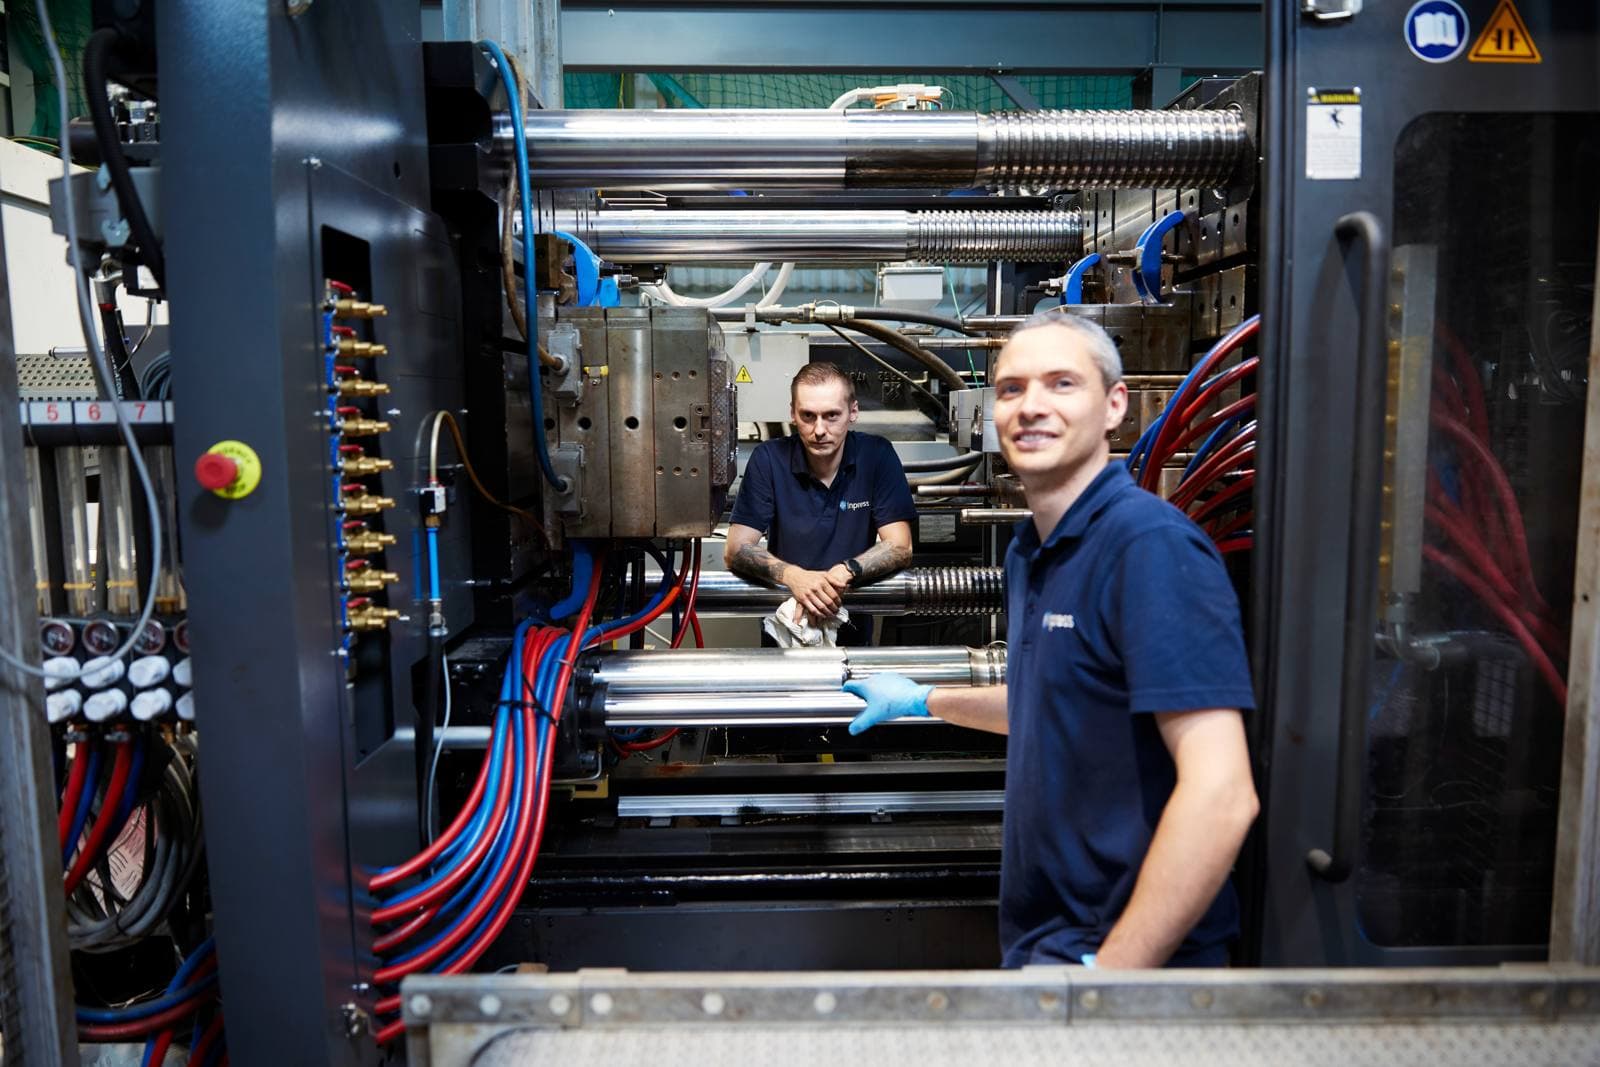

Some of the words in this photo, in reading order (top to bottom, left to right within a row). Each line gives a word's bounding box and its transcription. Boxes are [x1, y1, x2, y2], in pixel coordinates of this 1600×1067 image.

[47, 402, 59, 421] 5
[88, 403, 102, 421] 6
[135, 402, 146, 420] 7
